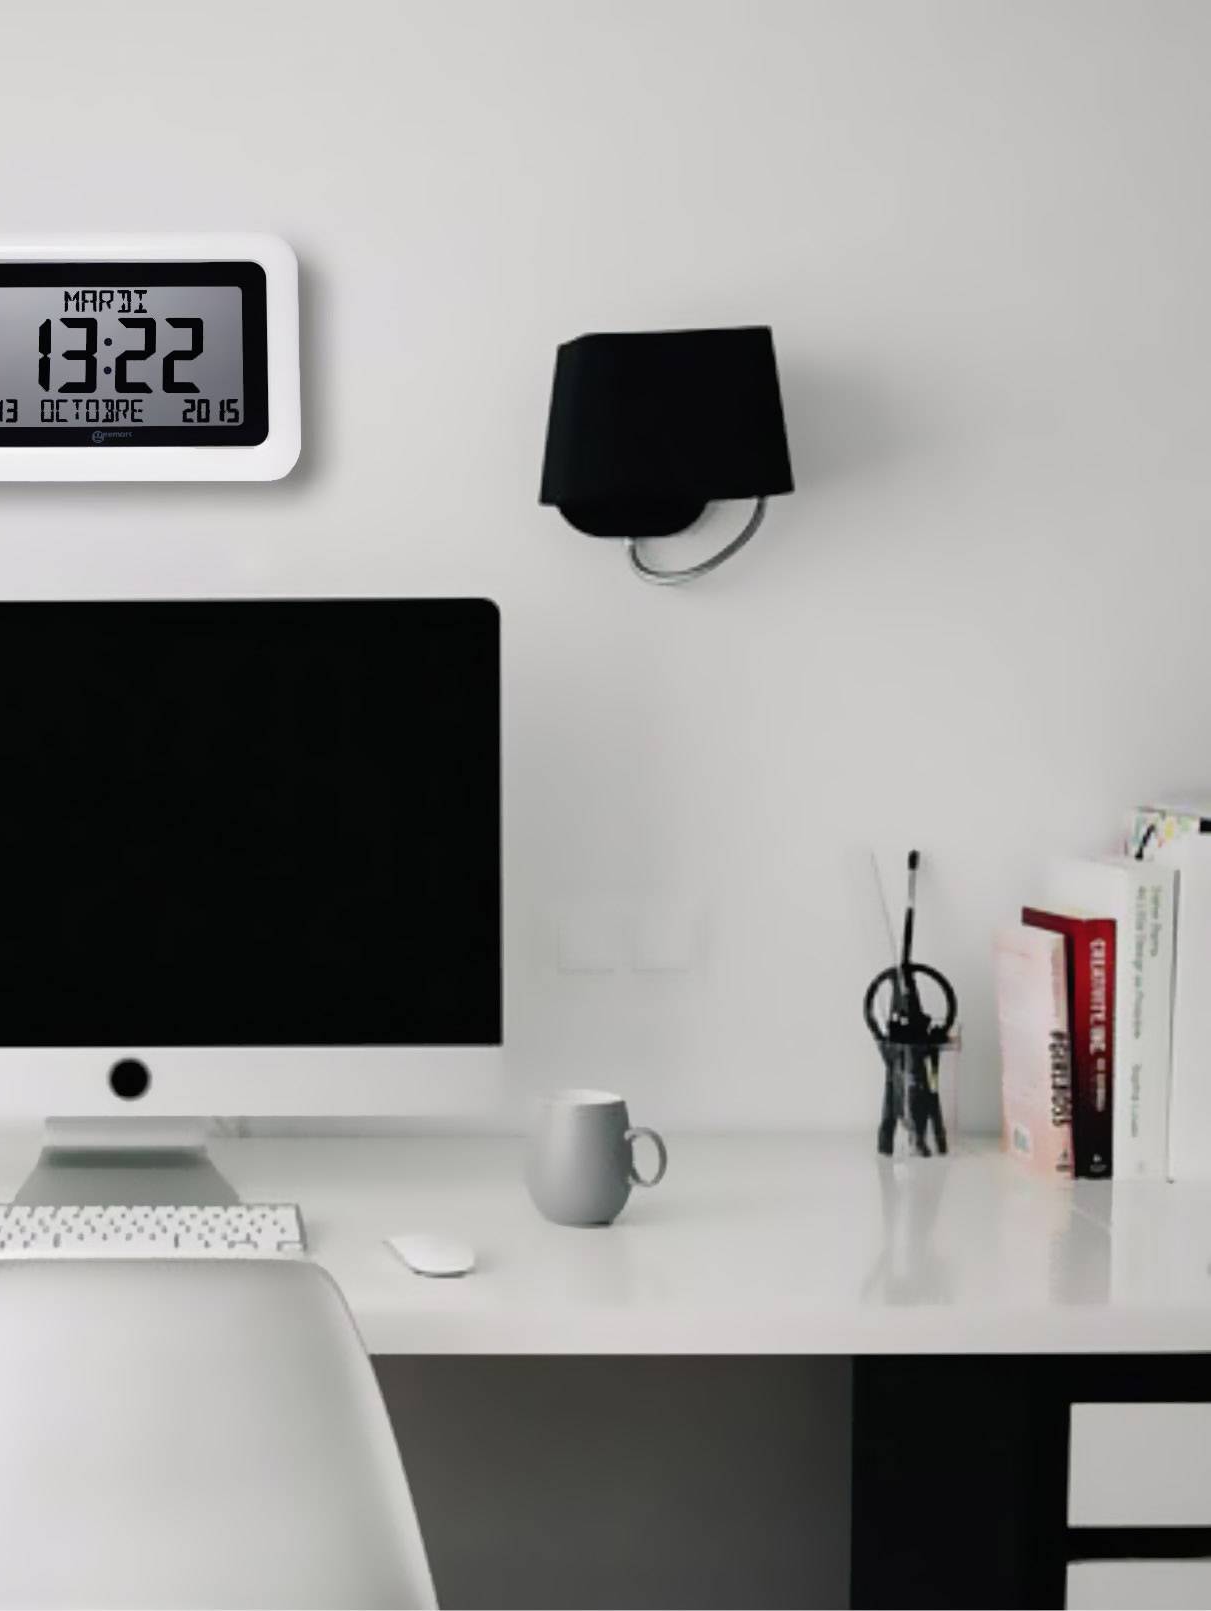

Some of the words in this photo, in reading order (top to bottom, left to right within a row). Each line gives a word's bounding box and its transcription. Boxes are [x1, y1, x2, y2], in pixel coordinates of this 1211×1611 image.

[64, 289, 148, 313] MARDI
[38, 317, 204, 394] 13:22
[40, 398, 144, 424] OCTOBRE
[182, 398, 240, 424] 2015
